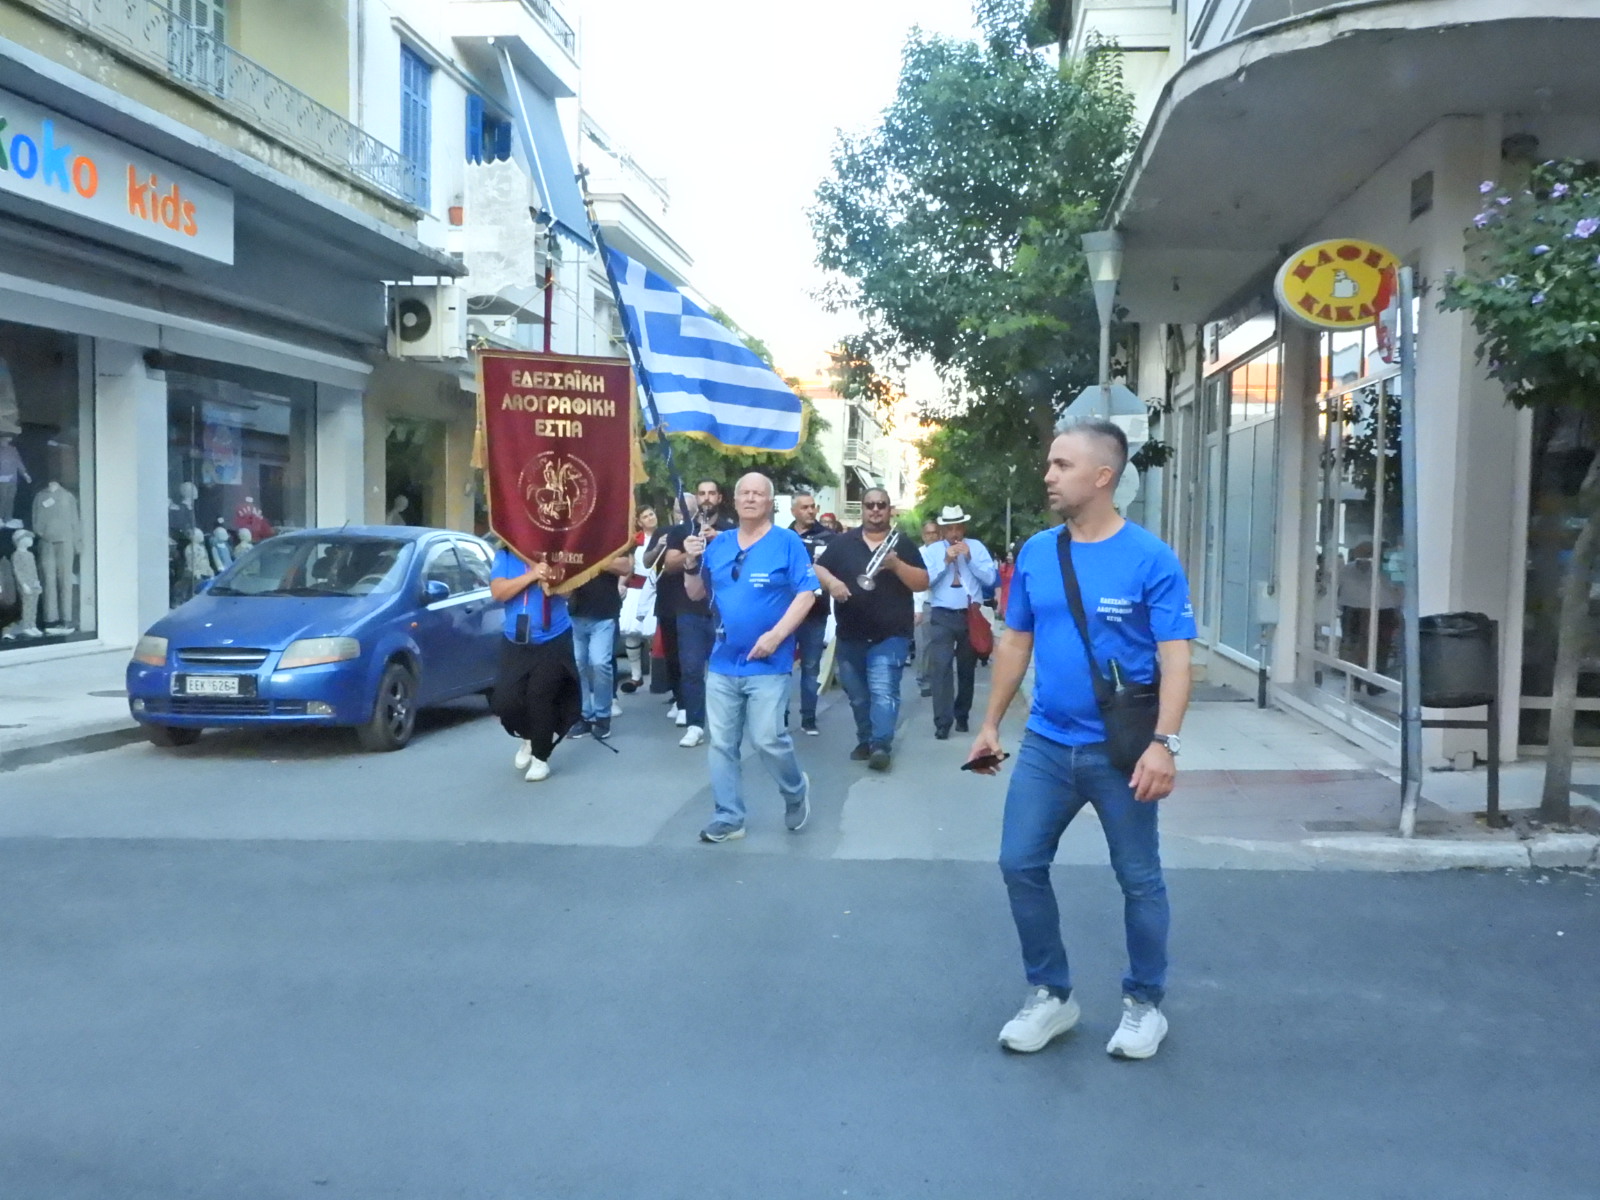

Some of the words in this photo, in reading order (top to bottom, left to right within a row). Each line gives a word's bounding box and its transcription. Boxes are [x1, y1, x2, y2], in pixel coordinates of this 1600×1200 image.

[126, 163, 198, 237] kids
[1298, 292, 1382, 322] ΚΑΚΑ
[511, 369, 605, 393] ΕΔΕΣΣΑΪΚΗ
[501, 393, 616, 417] ΛΑΟΓΡΑΦΙΚΗ
[535, 418, 583, 438] ΕΣΤΙΑ
